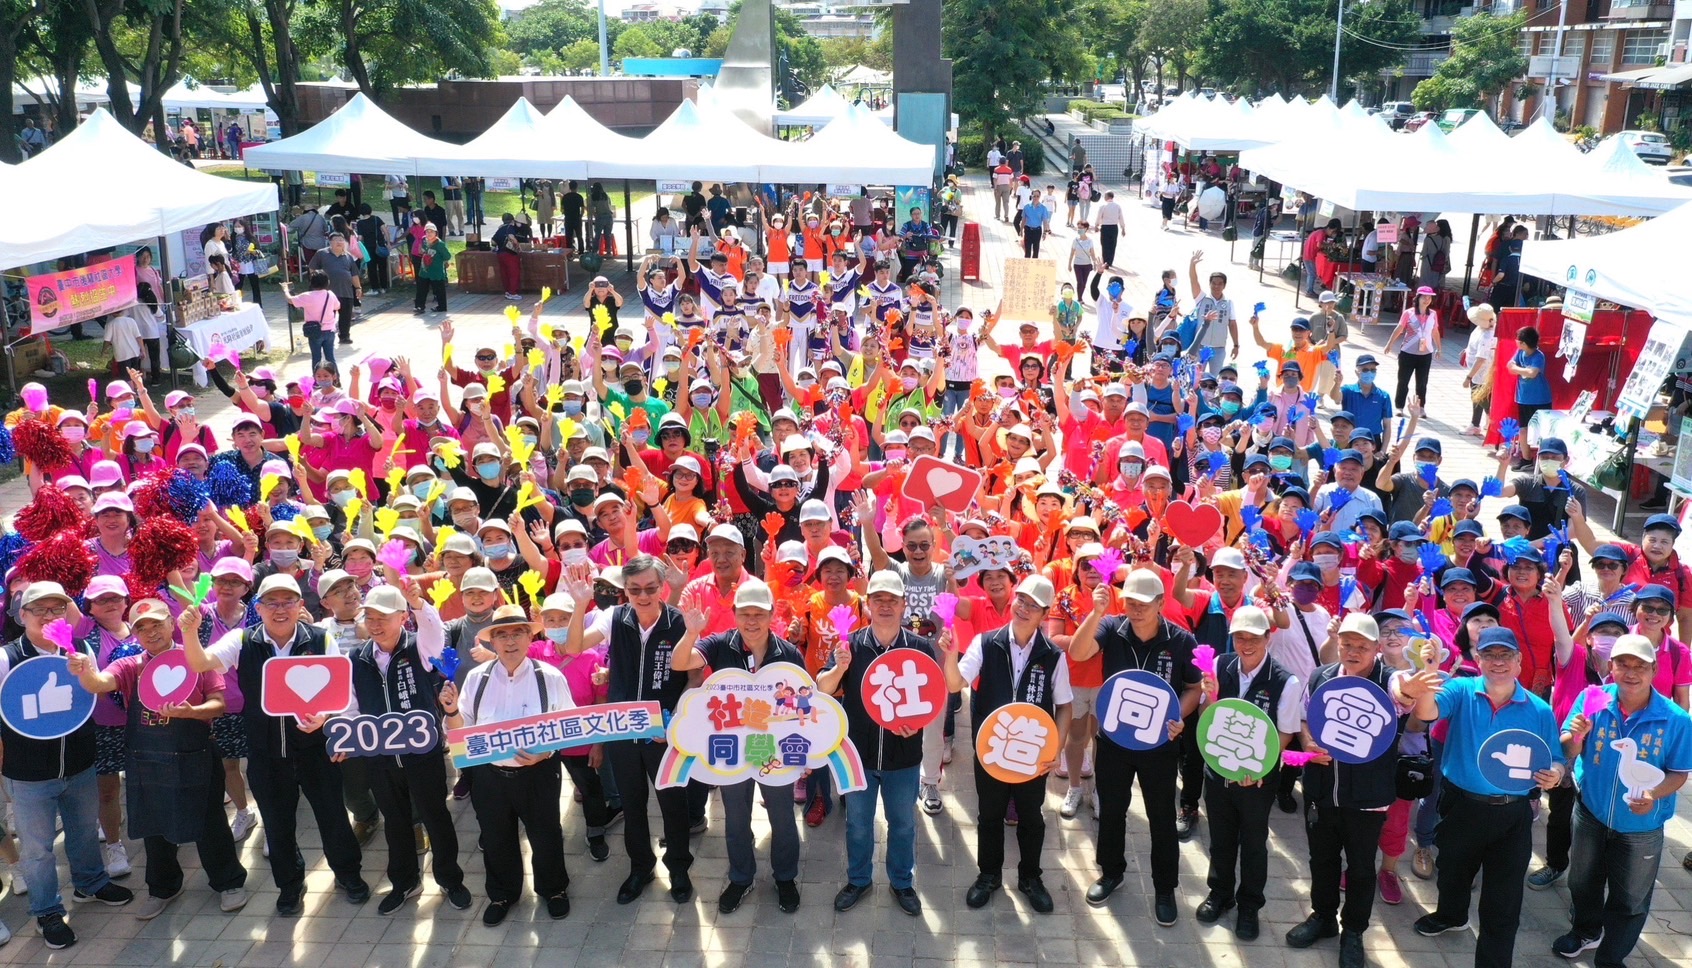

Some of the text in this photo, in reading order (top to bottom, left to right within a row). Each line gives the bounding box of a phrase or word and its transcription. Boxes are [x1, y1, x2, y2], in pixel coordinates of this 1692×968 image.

[788, 293, 812, 301] FREEDOM
[652, 661, 663, 690] 王偉誠
[706, 683, 774, 692] 2023臺中市社區文化季
[869, 659, 933, 722] 社
[707, 693, 772, 731] 社造
[1103, 676, 1171, 745] 同
[1320, 686, 1392, 758] 會
[330, 715, 431, 753] 2023
[466, 709, 650, 757] 臺中市社區文化季
[708, 733, 811, 768] 同學會
[983, 710, 1048, 776] 造
[1204, 705, 1269, 773] 學
